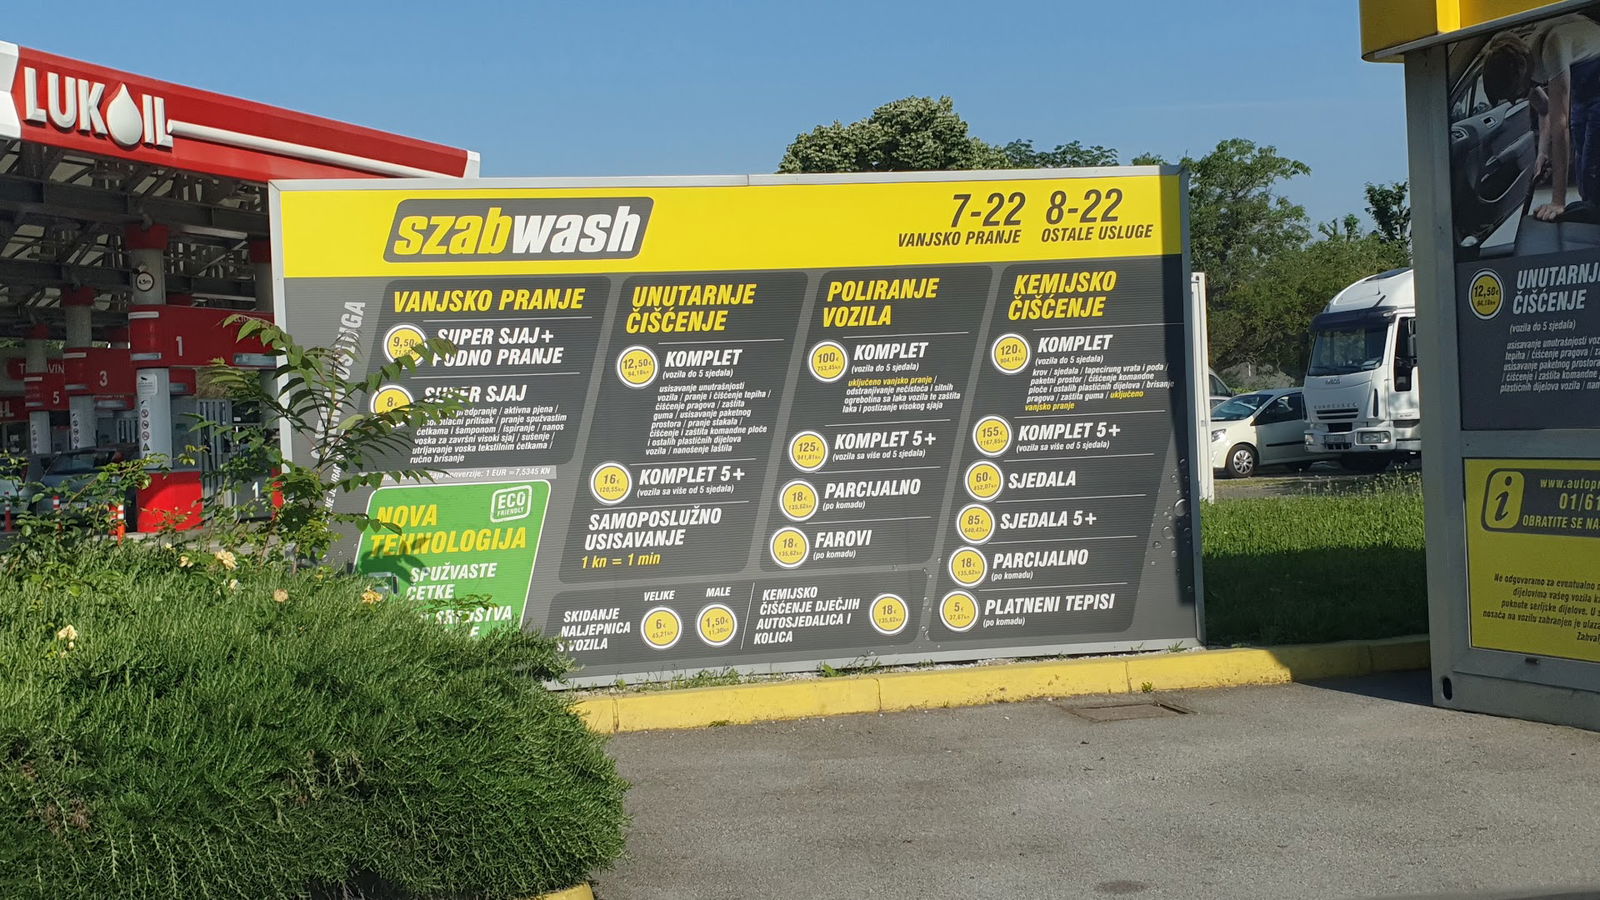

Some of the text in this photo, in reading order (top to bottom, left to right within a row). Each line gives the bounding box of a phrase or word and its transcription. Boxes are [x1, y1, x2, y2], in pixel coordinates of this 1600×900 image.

[951, 191, 1026, 228] 7-22
[1046, 188, 1123, 225] 8-22
[394, 206, 641, 255] szabwash
[899, 229, 1022, 247] VANJSKO PRANJE
[1041, 223, 1154, 243] OSTALE USLUGE
[827, 277, 940, 302] POLIRANJE
[1013, 270, 1117, 295] KEMIJSKO
[394, 287, 586, 313] VANJSKO PRANJE
[632, 284, 757, 308] UNUTARNJE
[1512, 288, 1587, 314] ČIŠĆENJE
[1008, 294, 1107, 320] ČIŠĆENJE
[625, 307, 729, 334] ČIŠĆENJE
[823, 305, 892, 328] VOZILA
[1509, 319, 1576, 334] (vozila do 5 sjedala)
[438, 328, 494, 346] SUPER
[1038, 334, 1113, 353] KOMPLET
[176, 336, 183, 357] 1
[853, 342, 929, 361] KOMPLET
[497, 347, 564, 365] PRANJE
[664, 349, 743, 368] KOMPLET
[1035, 355, 1104, 366] (vozila do 5 sjedala)
[662, 368, 734, 380] (vozila do 5 sjedala)
[851, 362, 920, 374] (vozila do 5 sjedala)
[99, 371, 108, 387] 3
[659, 382, 745, 393] usisavanje unutrašnjosti
[848, 376, 933, 388] uključeno vanjsko pranje
[53, 391, 60, 405] 5
[486, 384, 528, 402] SJAJ
[503, 405, 553, 415] aktivna pjena
[1025, 402, 1075, 412] vanjsko pranje
[414, 436, 437, 445] voska
[448, 434, 476, 444] završni
[477, 434, 500, 443] visoki
[501, 433, 515, 443] sjaj
[834, 431, 909, 450] KOMPLET
[1018, 422, 1094, 441] KOMPLET
[410, 452, 465, 463] ručno brisanje
[832, 452, 855, 462] (vozila
[866, 450, 881, 459] više
[882, 450, 891, 458] od
[892, 450, 897, 458] 5
[898, 448, 926, 459] sjedala)
[638, 466, 717, 485] KOMPLET
[1008, 470, 1076, 489] SJEDALA
[636, 488, 661, 498] (vozila
[672, 486, 687, 495] više
[688, 486, 698, 494] od
[699, 485, 704, 494] 5
[705, 484, 735, 495] sjedala)
[824, 478, 921, 499] PARCIJALNO
[497, 492, 526, 509] ECO
[822, 500, 866, 511] (po komadu)
[377, 504, 438, 528] NOVA
[497, 507, 525, 517] FRIENDLY
[588, 505, 722, 531] SAMOPOSLUŽNO
[1000, 511, 1068, 529] SJEDALA
[1522, 515, 1600, 530] OBRATITE SE NA
[370, 527, 527, 557] TEHNOLOGIJA
[584, 529, 686, 551] USISAVANJE
[815, 529, 872, 548] FAROVI
[581, 556, 588, 569] 1
[591, 555, 607, 568] kn
[627, 553, 634, 566] 1
[637, 552, 661, 565] min
[813, 549, 856, 560] (po komadu)
[992, 549, 1089, 569] PARCIJALNO
[410, 562, 498, 583] SPUŽVASTE
[991, 570, 1034, 581] (po komadu)
[406, 581, 455, 601] ČETKE
[643, 590, 675, 602] VELIKE
[705, 586, 732, 598] MALE
[762, 586, 818, 601] KEMIJSKO
[759, 597, 860, 616] ČIŠĆENJE DJEČJIH
[984, 593, 1116, 615] PLATNENI TEPISI
[564, 608, 620, 623] SKIDANJE
[756, 613, 852, 630] AUTOSJEDALICA I
[560, 622, 631, 638] NALJEPNICA
[754, 630, 793, 645] KOLICA
[568, 638, 608, 652] VOZILA
